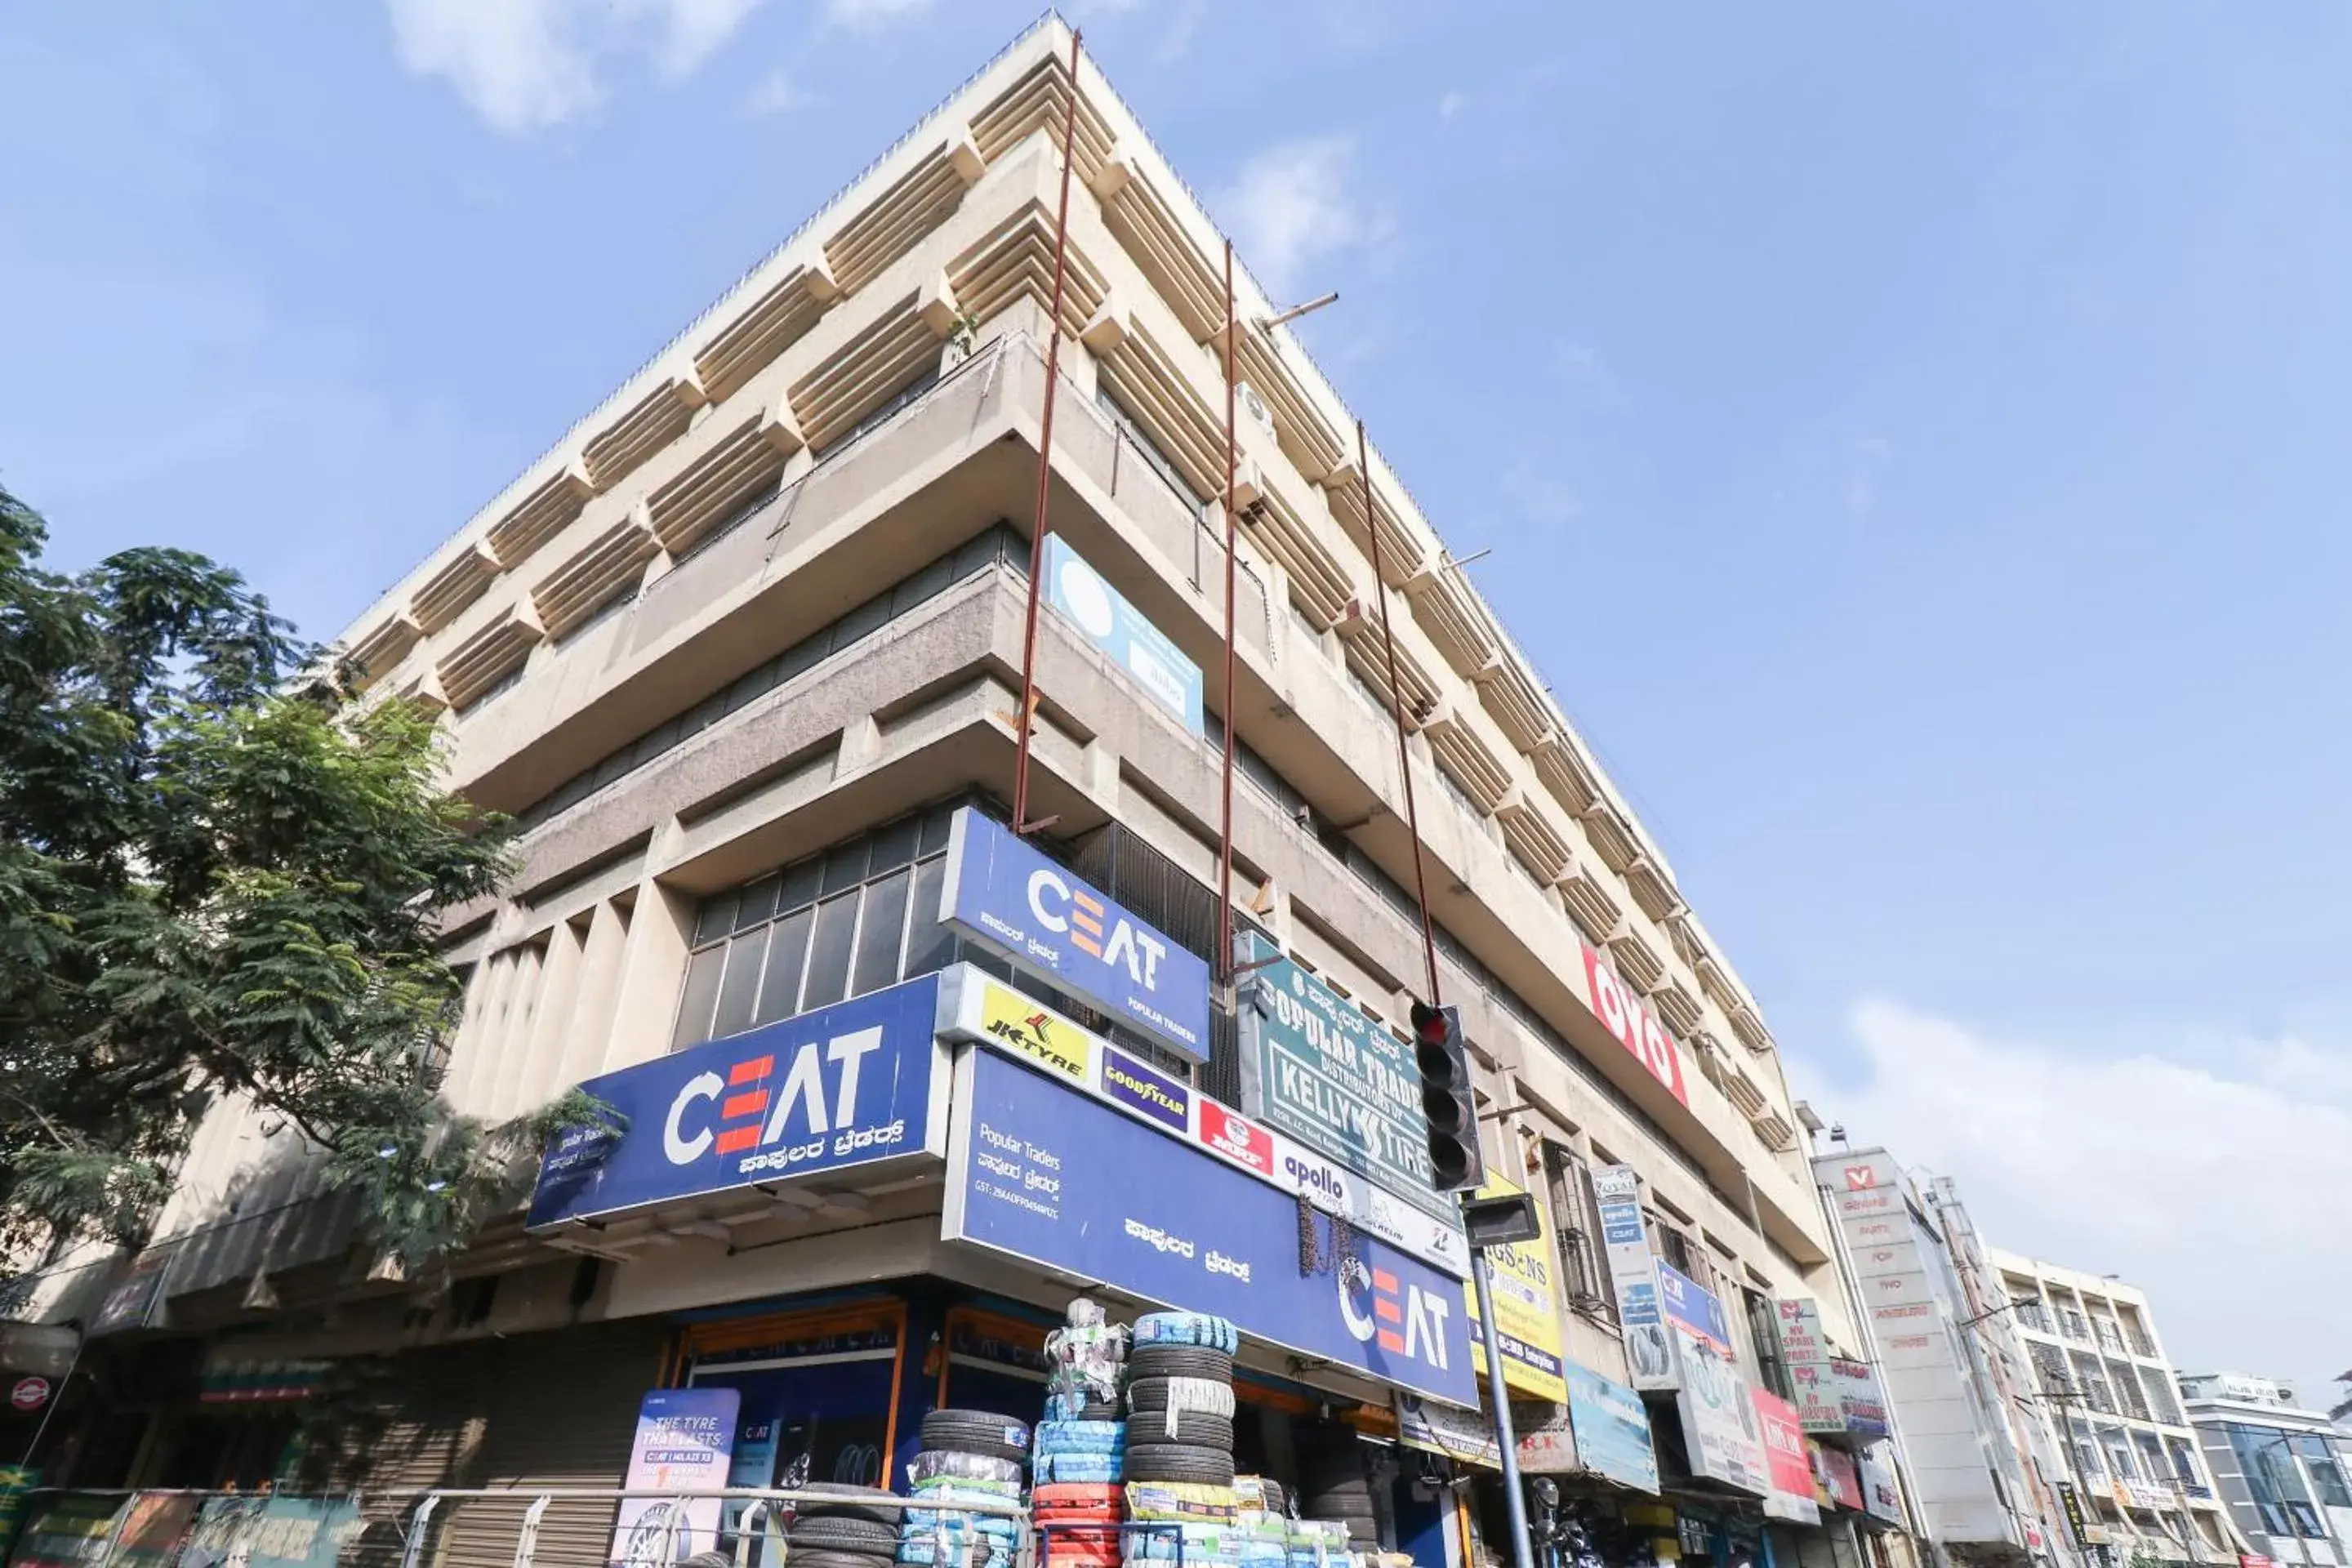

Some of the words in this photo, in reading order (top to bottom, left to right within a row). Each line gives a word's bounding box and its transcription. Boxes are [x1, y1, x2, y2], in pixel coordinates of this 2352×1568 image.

[1027, 869, 1167, 991] CEAT
[1128, 996, 1163, 1024] POPULAR
[1164, 1018, 1196, 1044] TRADERS
[1594, 963, 1674, 1089] OYO
[663, 1026, 884, 1166] CEAT
[1105, 1065, 1185, 1116] GOODYEAR
[1281, 1057, 1351, 1133] KELLY
[1361, 1049, 1424, 1117] TRADE
[980, 1122, 1022, 1154] Popular
[1023, 1140, 1060, 1170] Traders
[1285, 1156, 1343, 1200] apollo
[1338, 1256, 1450, 1370] CEAT
[653, 1417, 681, 1430] THE
[684, 1417, 719, 1431] TYRE
